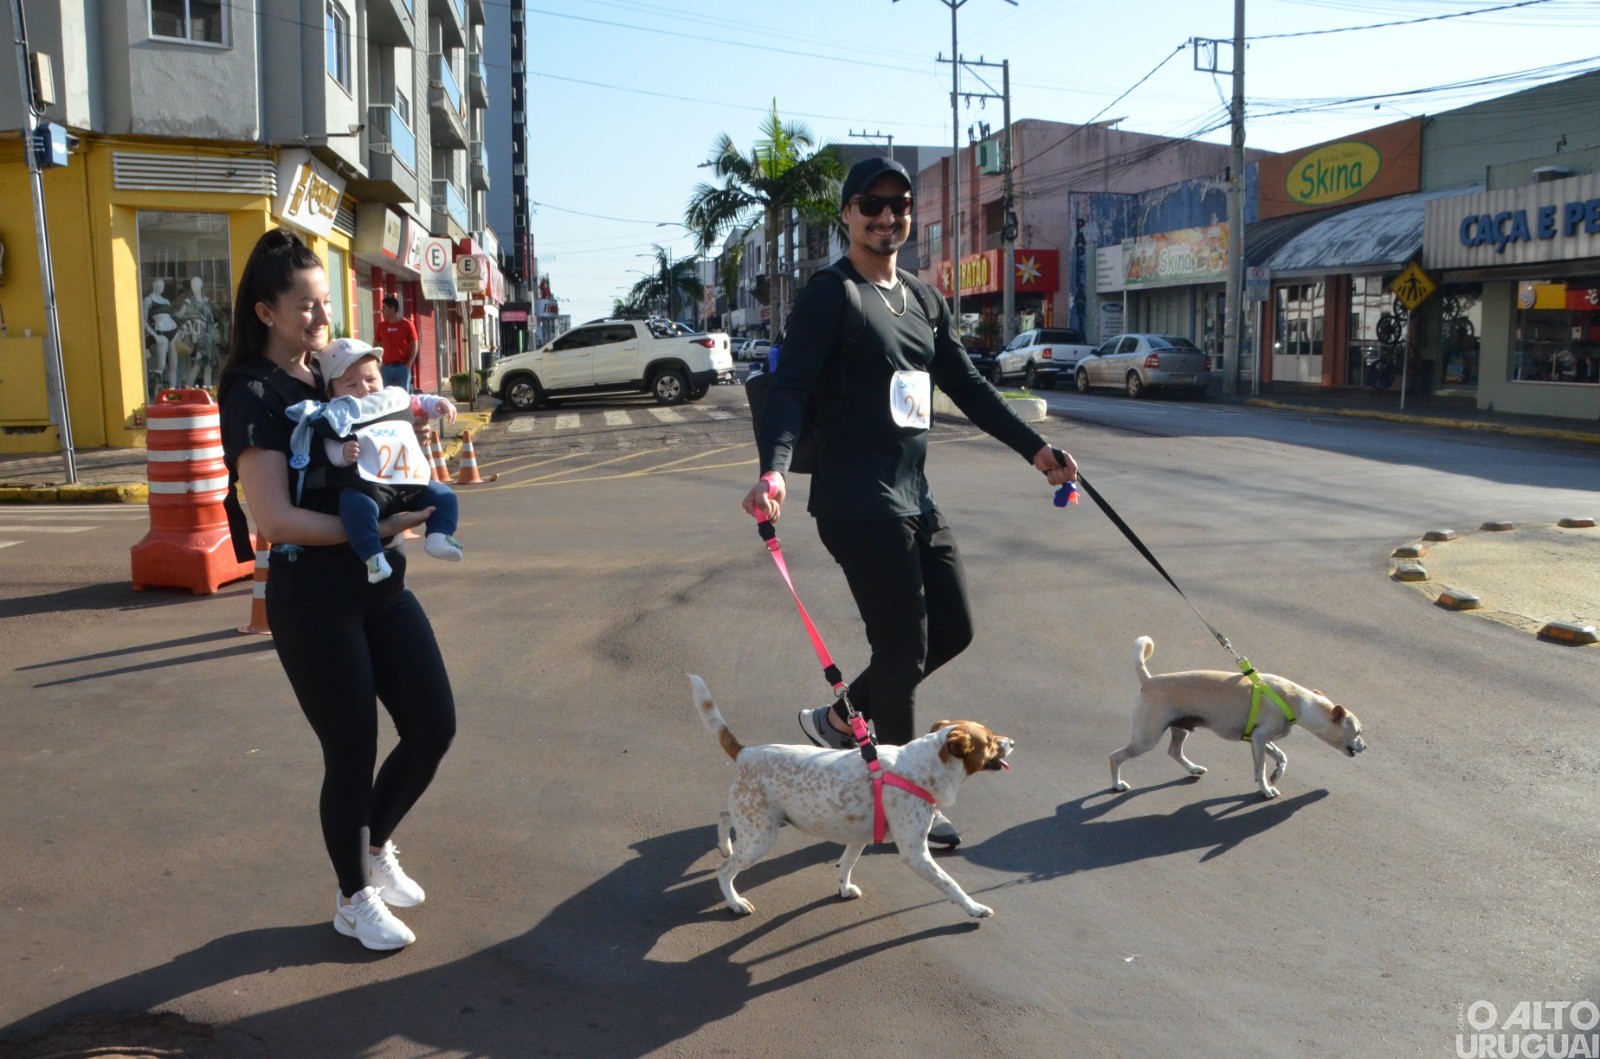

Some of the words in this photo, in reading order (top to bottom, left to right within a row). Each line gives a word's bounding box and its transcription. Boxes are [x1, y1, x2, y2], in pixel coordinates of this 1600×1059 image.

[1300, 158, 1362, 199] Skina
[1460, 209, 1532, 254] CAÇA
[1538, 205, 1557, 240] E
[431, 248, 441, 267] E
[464, 259, 472, 272] E
[951, 255, 988, 291] RATÃO
[1159, 247, 1192, 274] Skina
